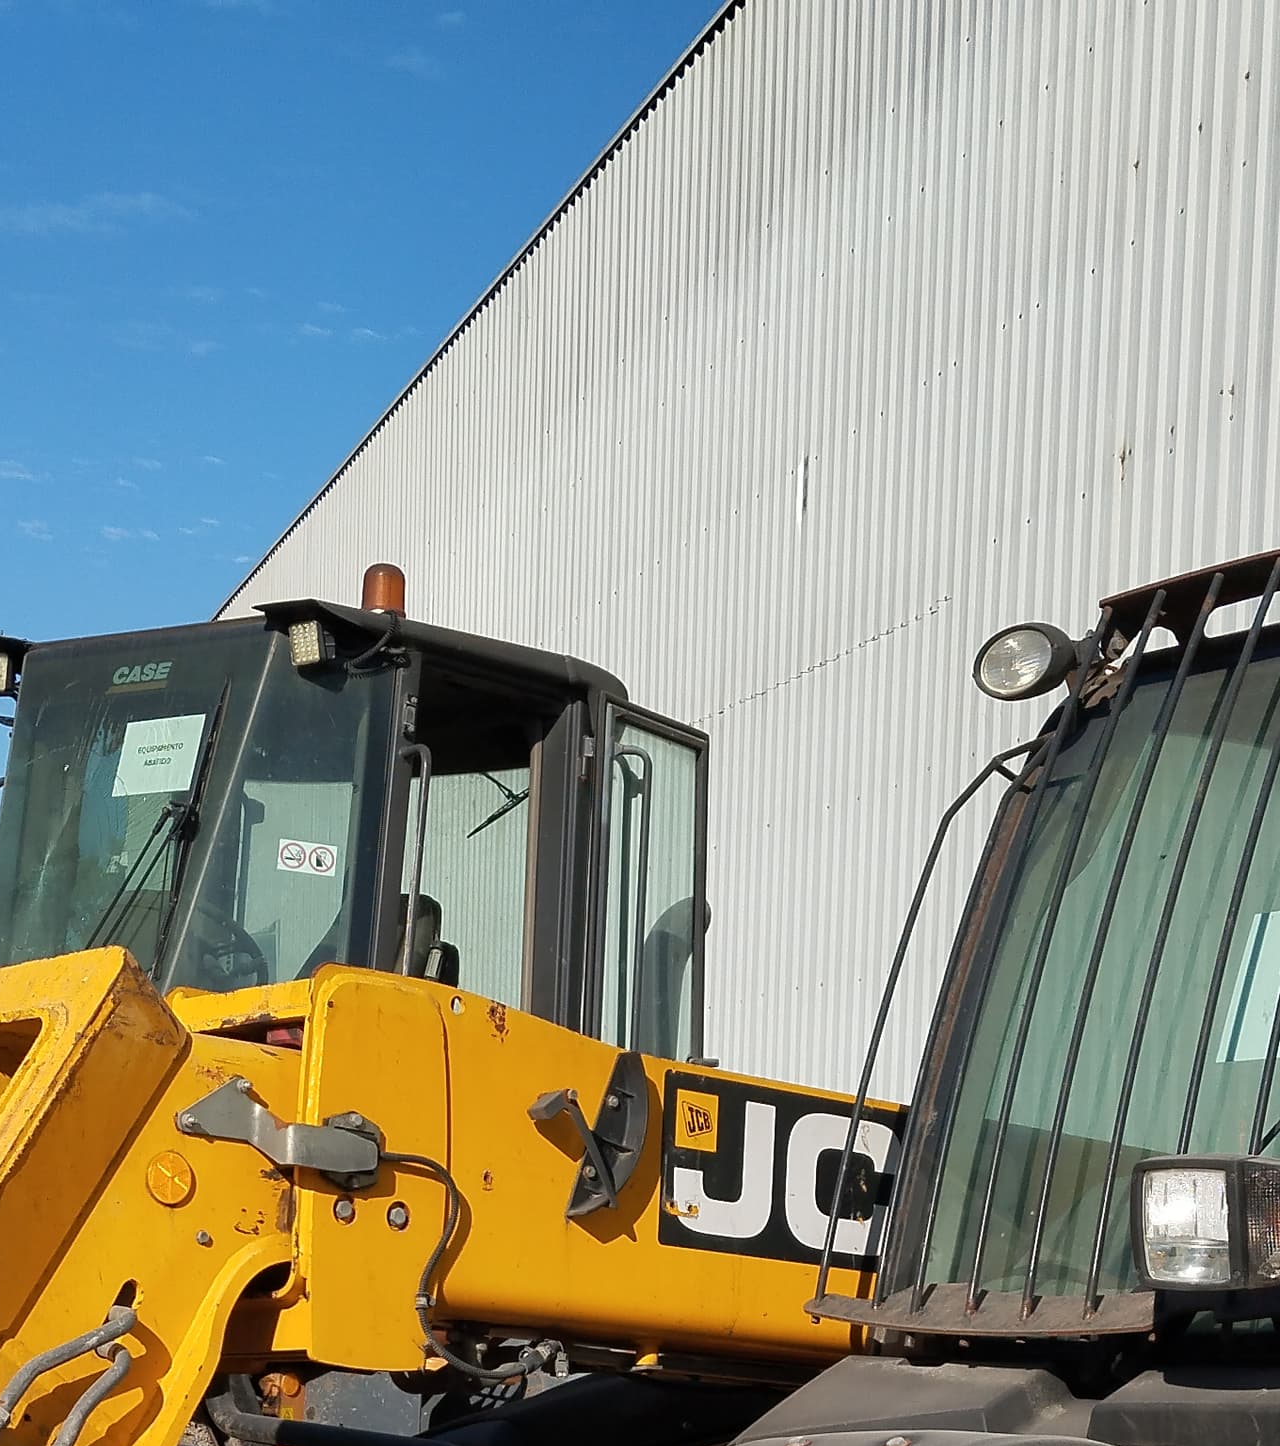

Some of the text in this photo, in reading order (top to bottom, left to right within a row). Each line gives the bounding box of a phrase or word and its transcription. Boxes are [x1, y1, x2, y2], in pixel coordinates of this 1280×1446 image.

[112, 661, 173, 685] CASE
[687, 1107, 711, 1133] JCB
[673, 1100, 900, 1256] JC
